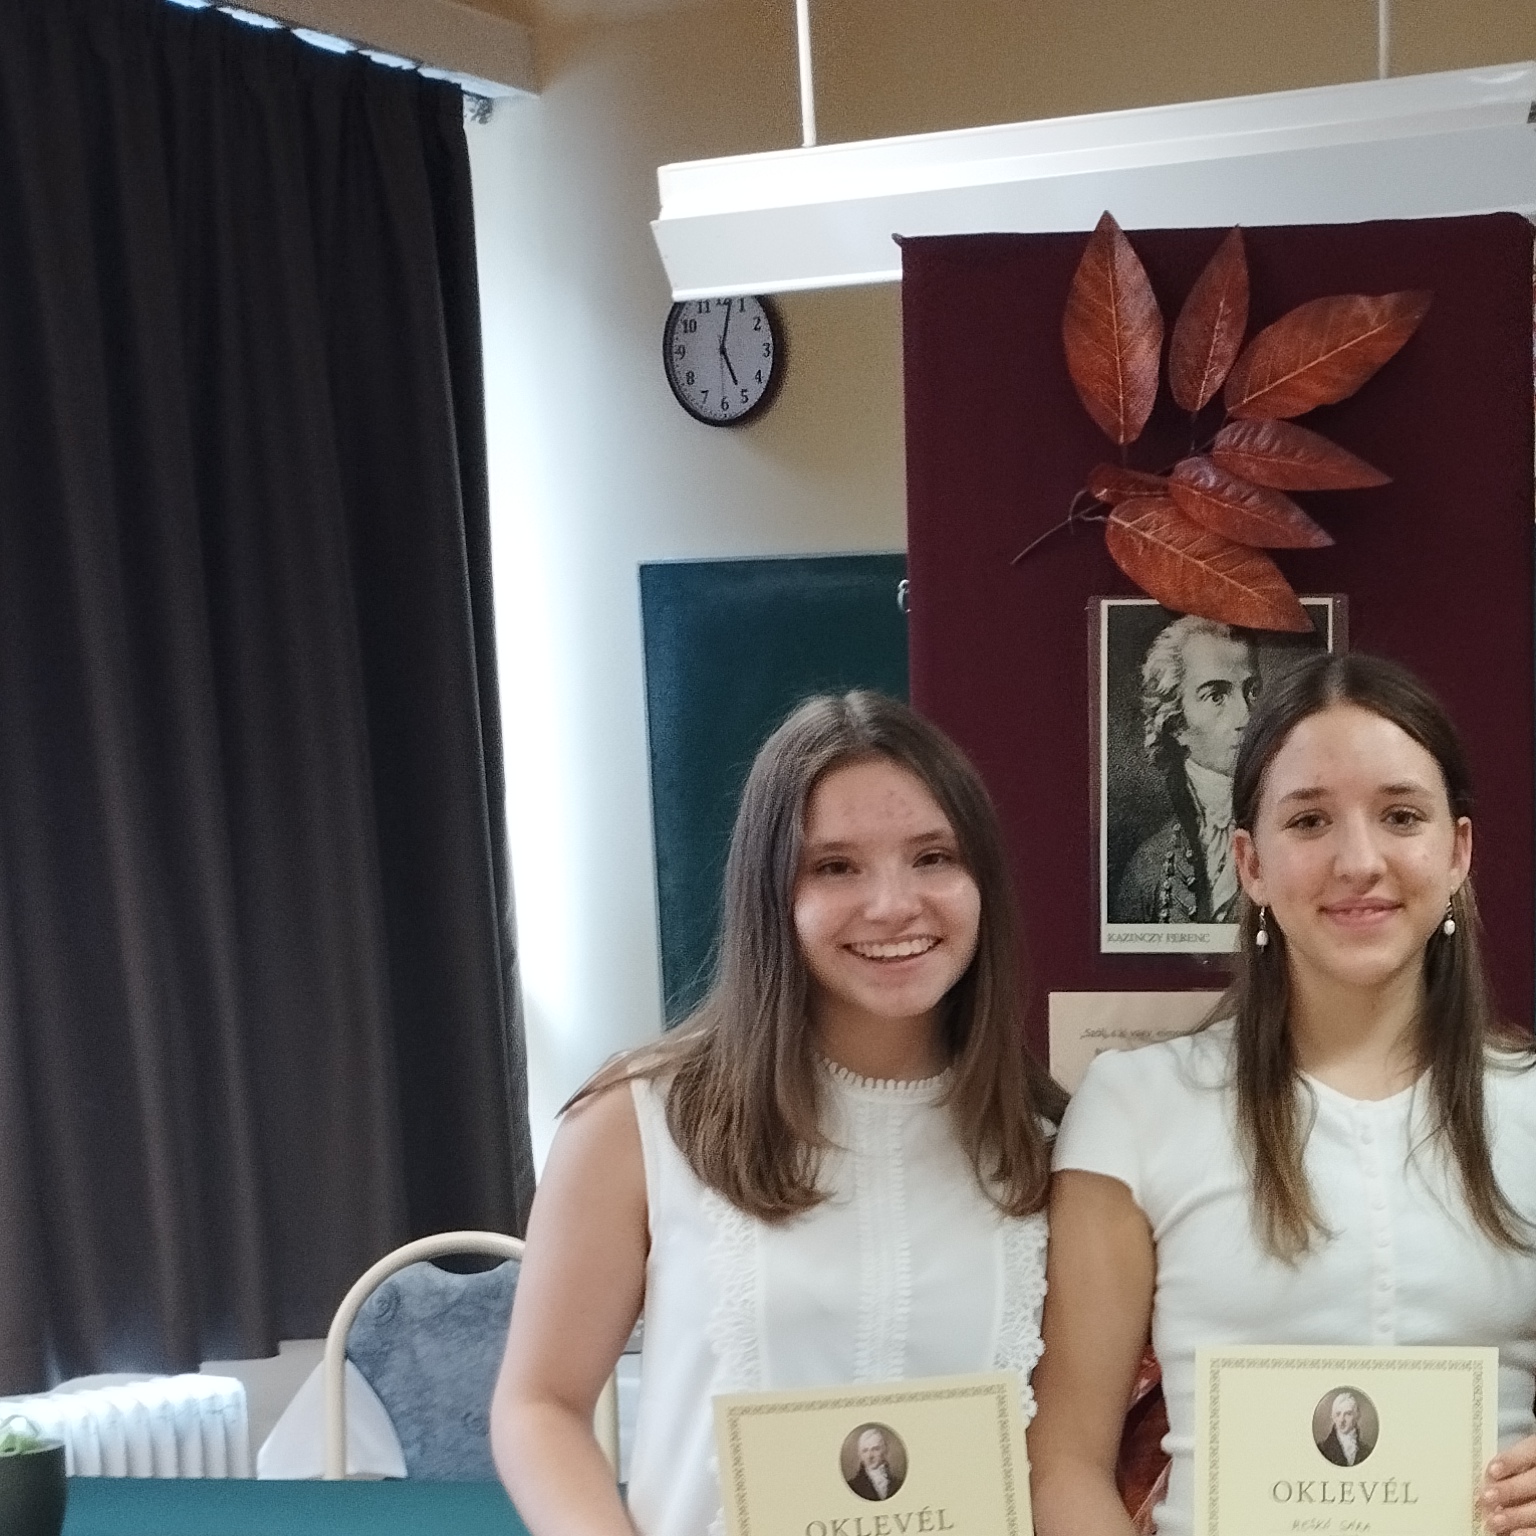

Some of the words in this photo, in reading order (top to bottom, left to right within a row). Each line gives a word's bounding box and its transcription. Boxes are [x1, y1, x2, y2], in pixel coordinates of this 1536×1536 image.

[682, 319, 697, 333] 10
[753, 316, 762, 331] 2
[676, 344, 686, 360] 9
[762, 342, 771, 358] 3
[685, 370, 695, 385] 8
[754, 369, 762, 384] 4
[700, 389, 709, 404] 7
[721, 396, 729, 411] 6
[740, 389, 749, 404] 5
[1107, 933, 1164, 943] KAZINCZY
[1166, 933, 1211, 943] FERENC
[1272, 1477, 1419, 1505] OKLEVÉL
